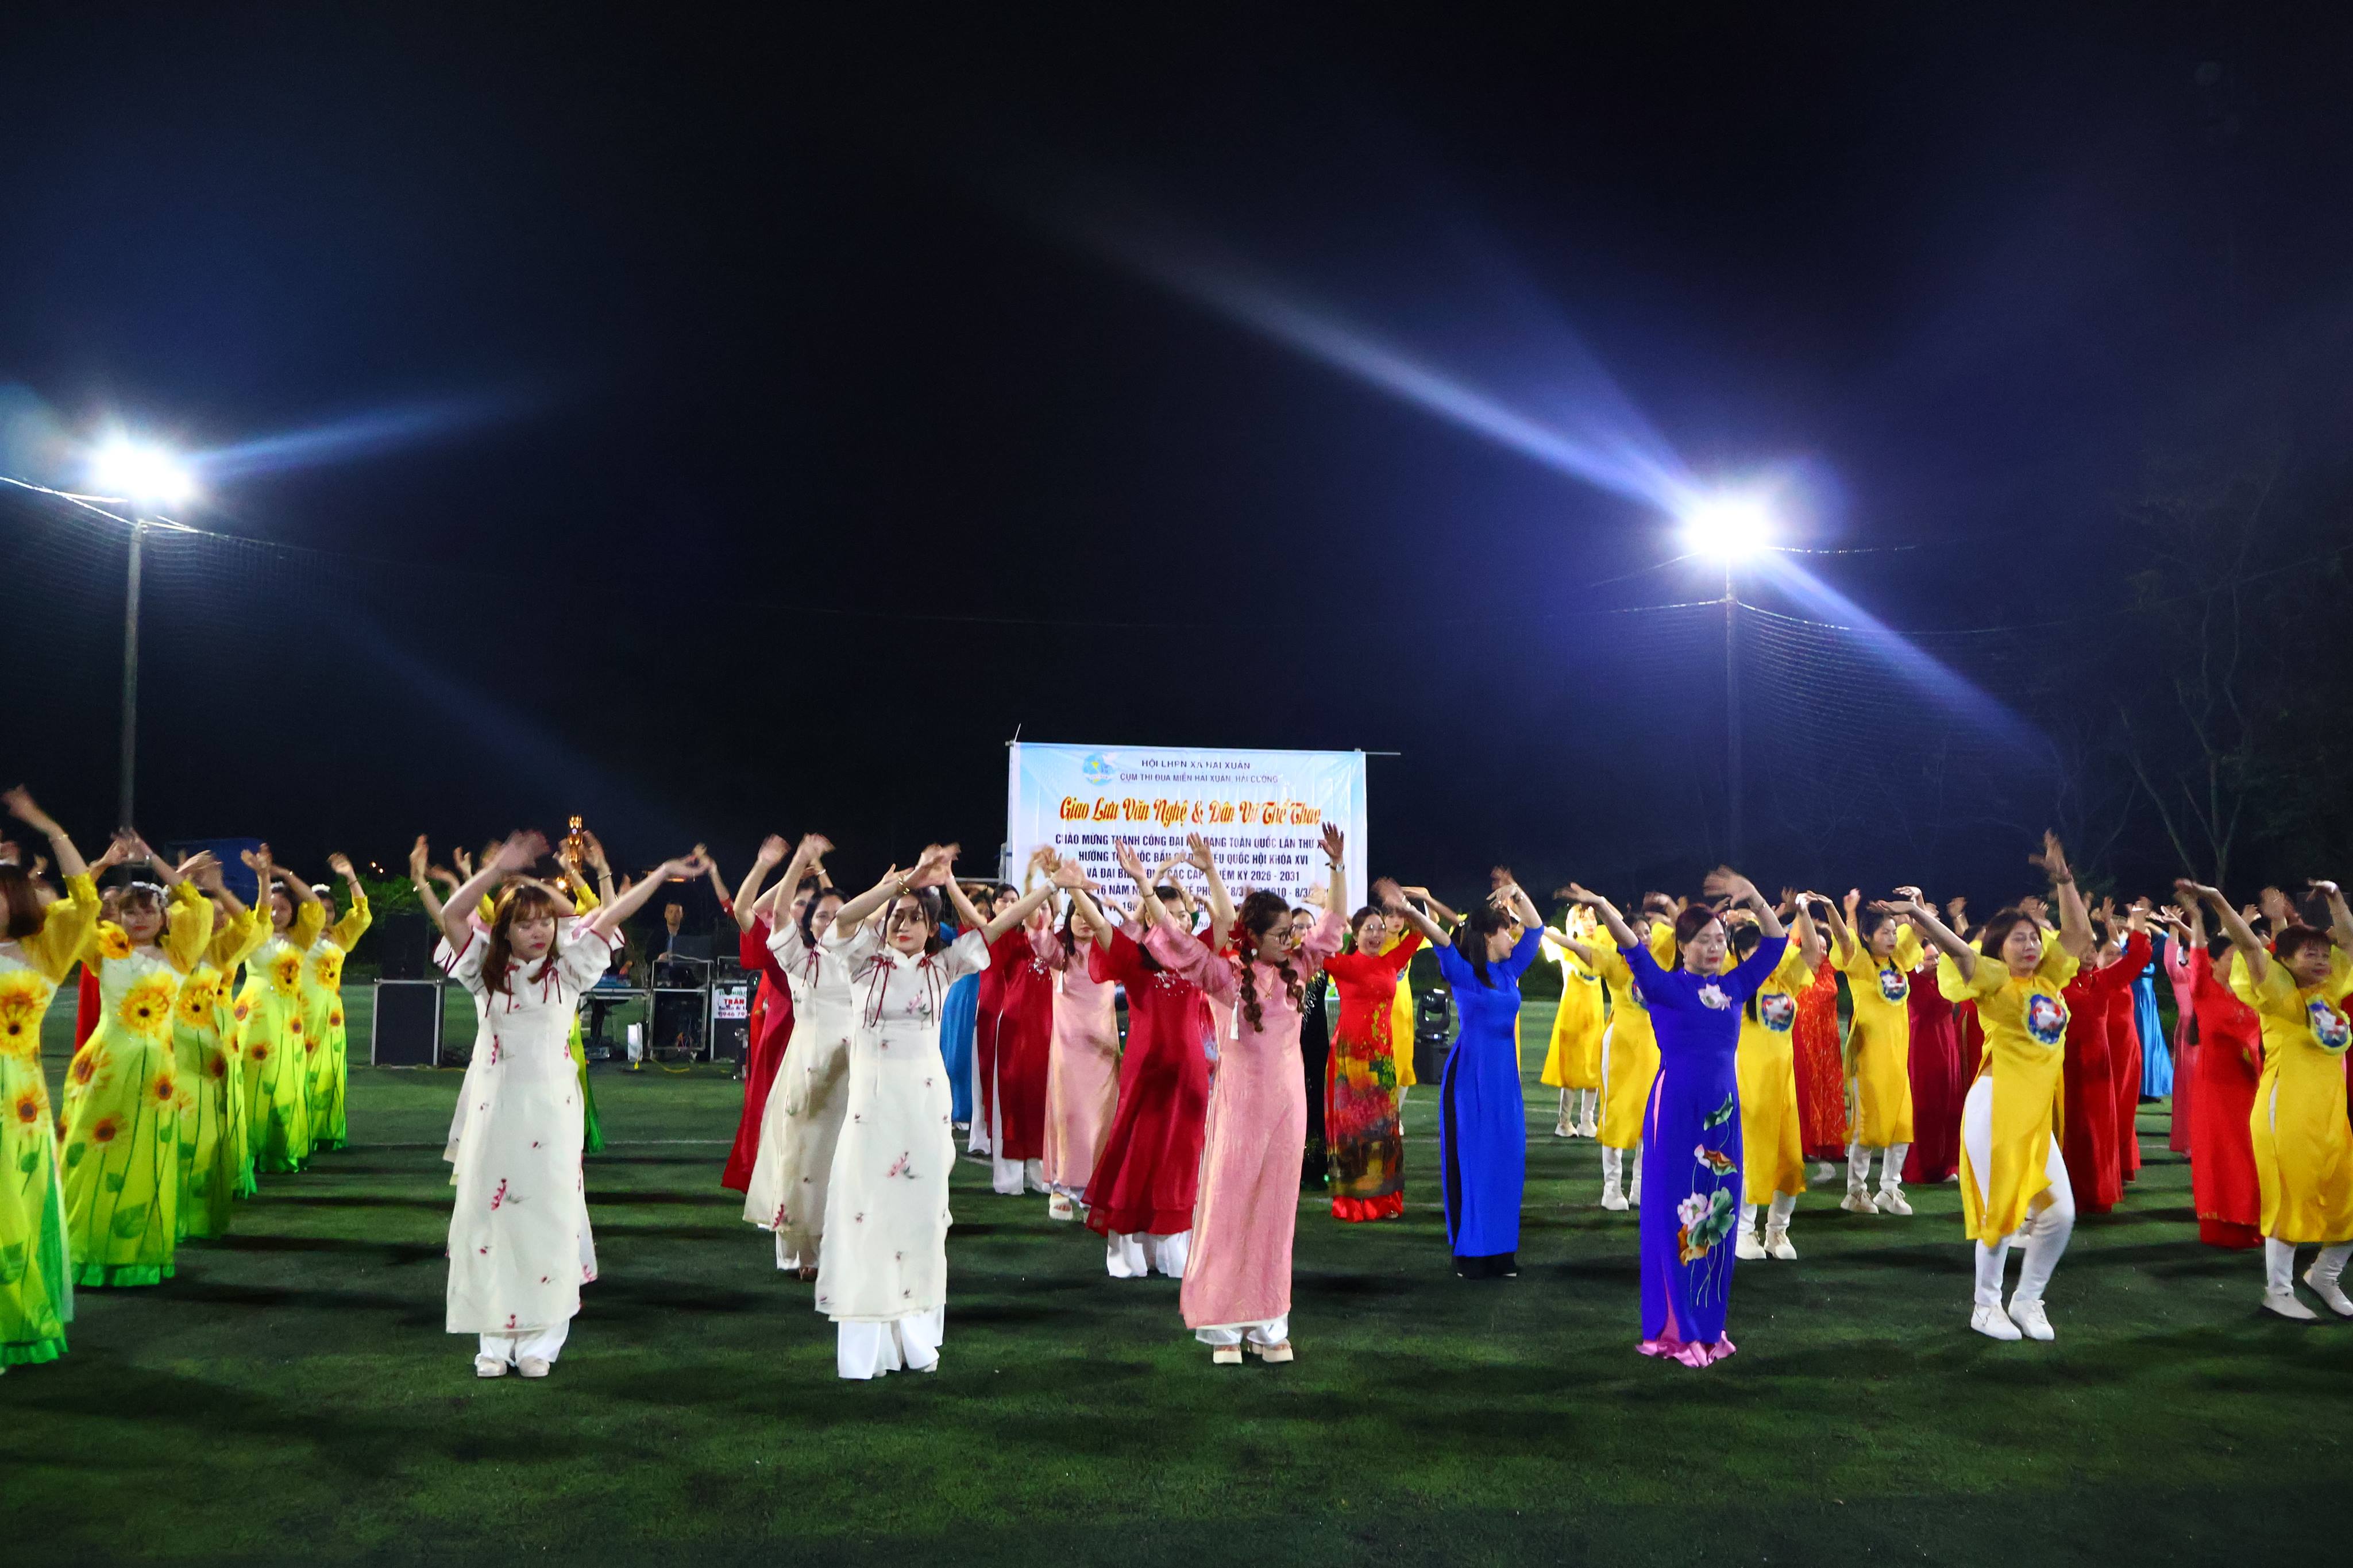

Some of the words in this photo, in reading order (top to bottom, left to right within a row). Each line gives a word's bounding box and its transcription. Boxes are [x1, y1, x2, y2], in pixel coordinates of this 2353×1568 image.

[1142, 758, 1158, 768] HỘI
[1120, 773, 1137, 783] CỤM
[1155, 774, 1171, 782] ĐUA
[1060, 795, 1089, 821] Giao
[1091, 796, 1119, 822] Lưu
[1123, 797, 1150, 822] Văn
[1153, 798, 1189, 828] Nghệ
[1190, 801, 1203, 825] &
[1209, 799, 1236, 825] Dân
[1262, 797, 1287, 825] Thể
[1290, 801, 1321, 826] Thao
[1055, 832, 1079, 845] CHÀO
[1082, 832, 1109, 845] MỪNG
[1143, 833, 1166, 846] CÔNG
[1169, 836, 1183, 849] ĐẠI
[1229, 836, 1251, 848] TOÀN
[1254, 835, 1276, 849] QUỐC
[1298, 837, 1315, 849] THỨ
[1079, 849, 1109, 862] HƯỚNG
[1227, 850, 1249, 865] QUỐC
[1252, 852, 1267, 867] HỘI
[1269, 852, 1292, 865] KHÓA
[1295, 854, 1308, 866] XVI
[1087, 866, 1097, 878] VÀ
[1100, 868, 1115, 881] ĐẠI
[1237, 868, 1248, 880] KỲ
[1251, 870, 1271, 880] 2026
[1280, 871, 1299, 881] 2031
[1109, 883, 1129, 895] NĂM
